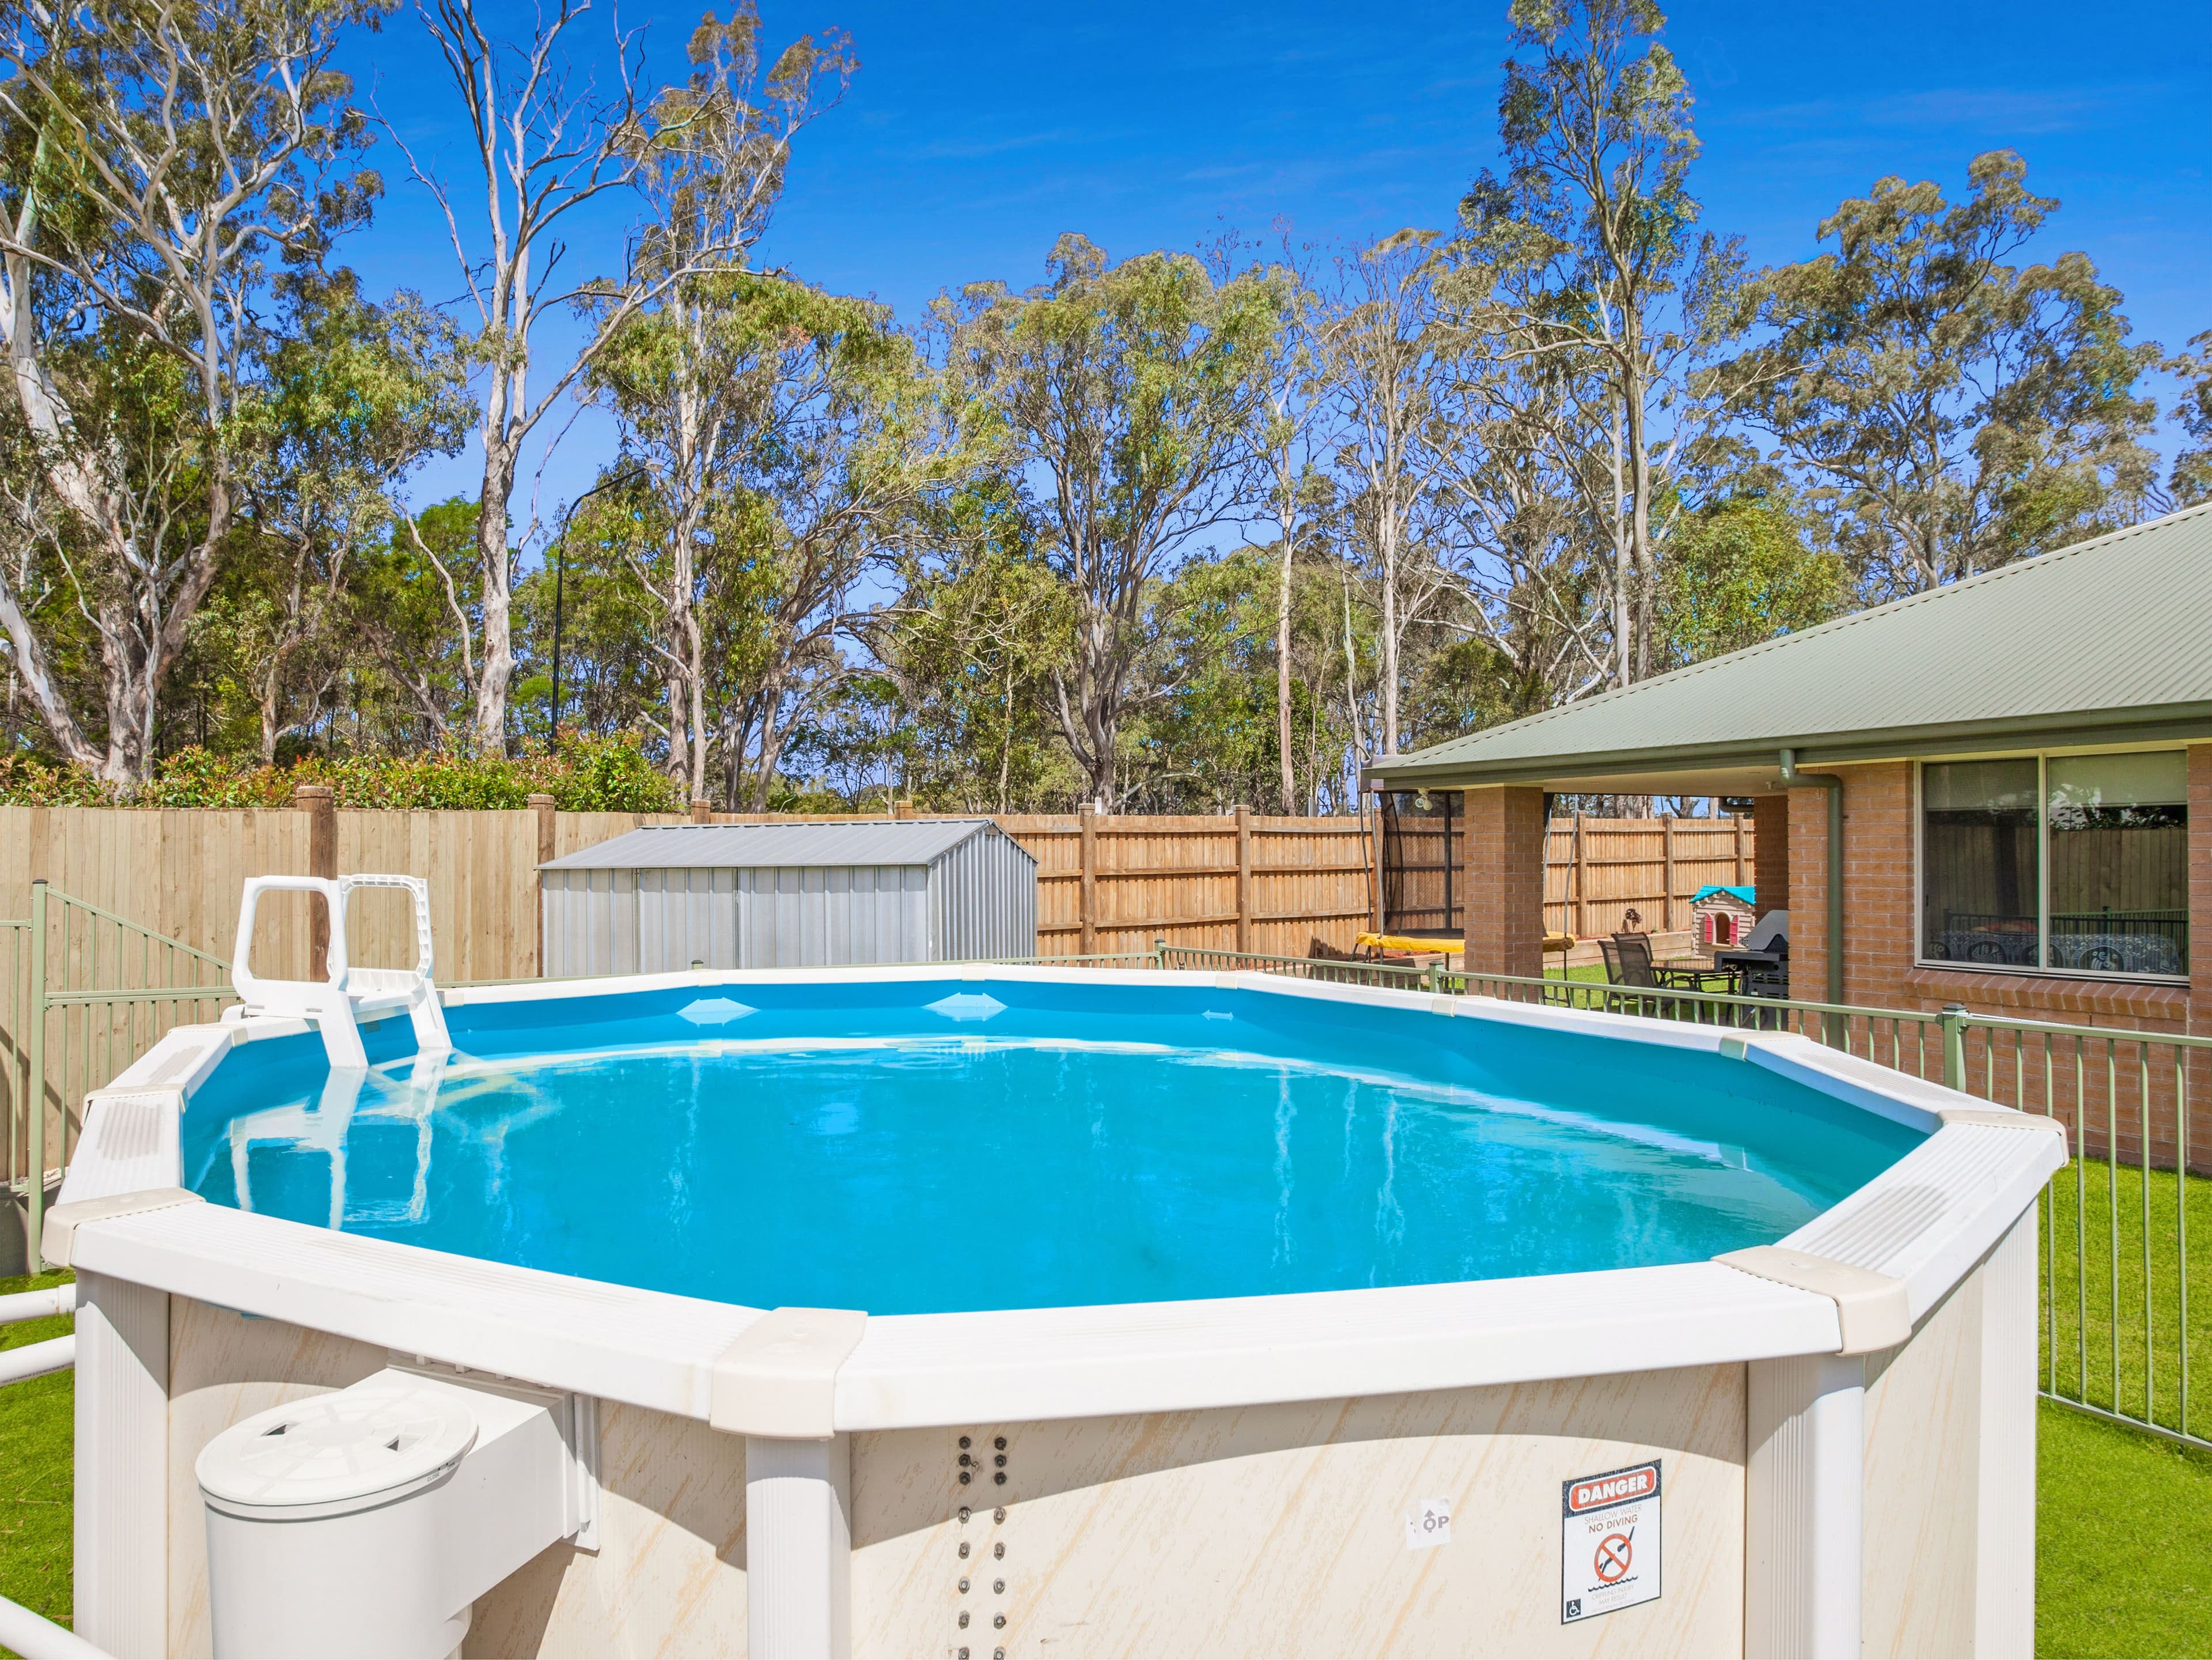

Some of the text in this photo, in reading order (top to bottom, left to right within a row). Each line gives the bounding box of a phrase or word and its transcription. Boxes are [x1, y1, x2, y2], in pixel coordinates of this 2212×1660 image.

[1578, 1475, 1648, 1504] DANGER
[1585, 1504, 1642, 1525] SHALLOW WATER
[1589, 1514, 1638, 1533] NO DIVING
[1611, 1593, 1627, 1602] RESULT
